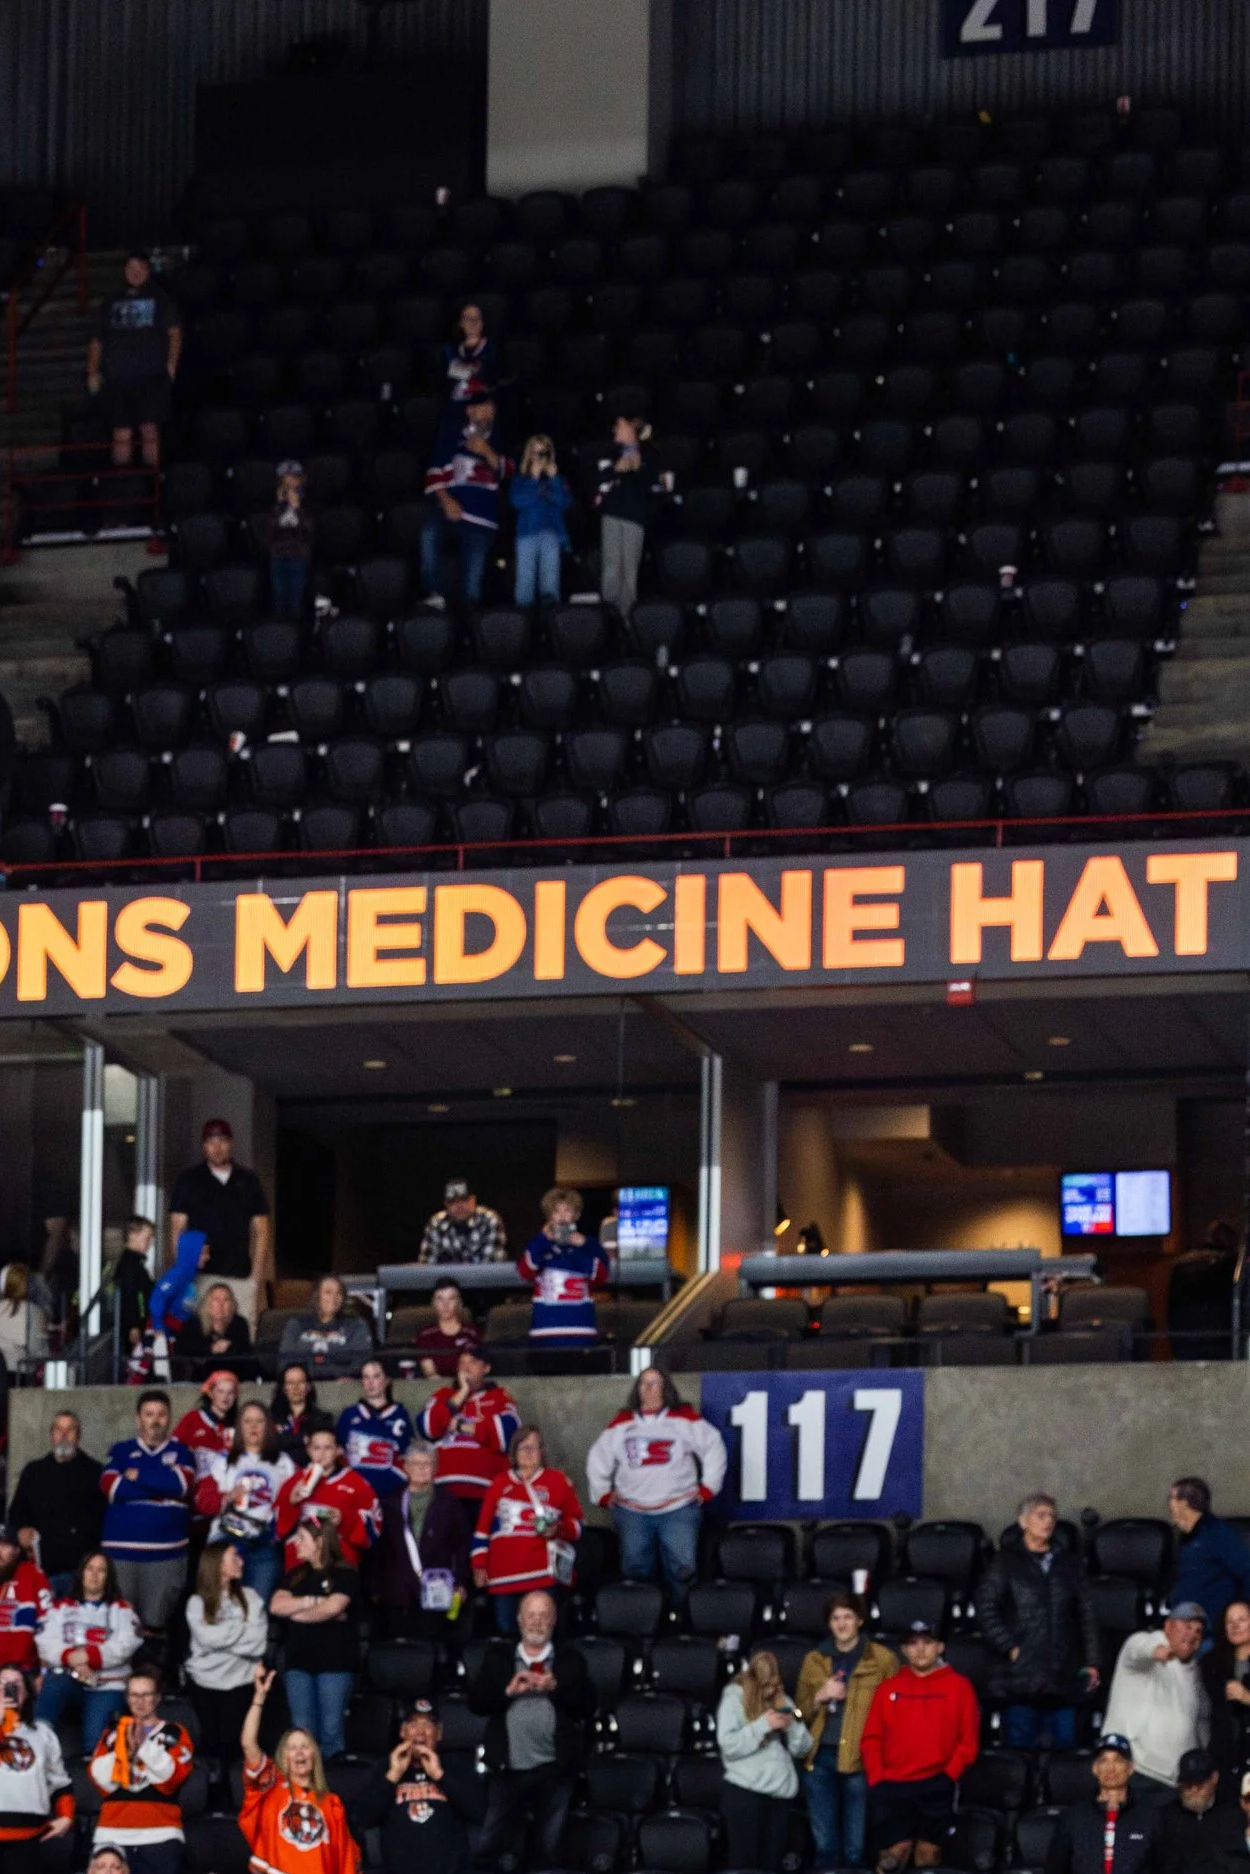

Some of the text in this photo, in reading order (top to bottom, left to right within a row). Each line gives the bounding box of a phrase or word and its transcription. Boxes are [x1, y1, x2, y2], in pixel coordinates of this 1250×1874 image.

[235, 866, 906, 993] MEDICINE
[950, 851, 1238, 965] HAT
[731, 1389, 902, 1502] 117
